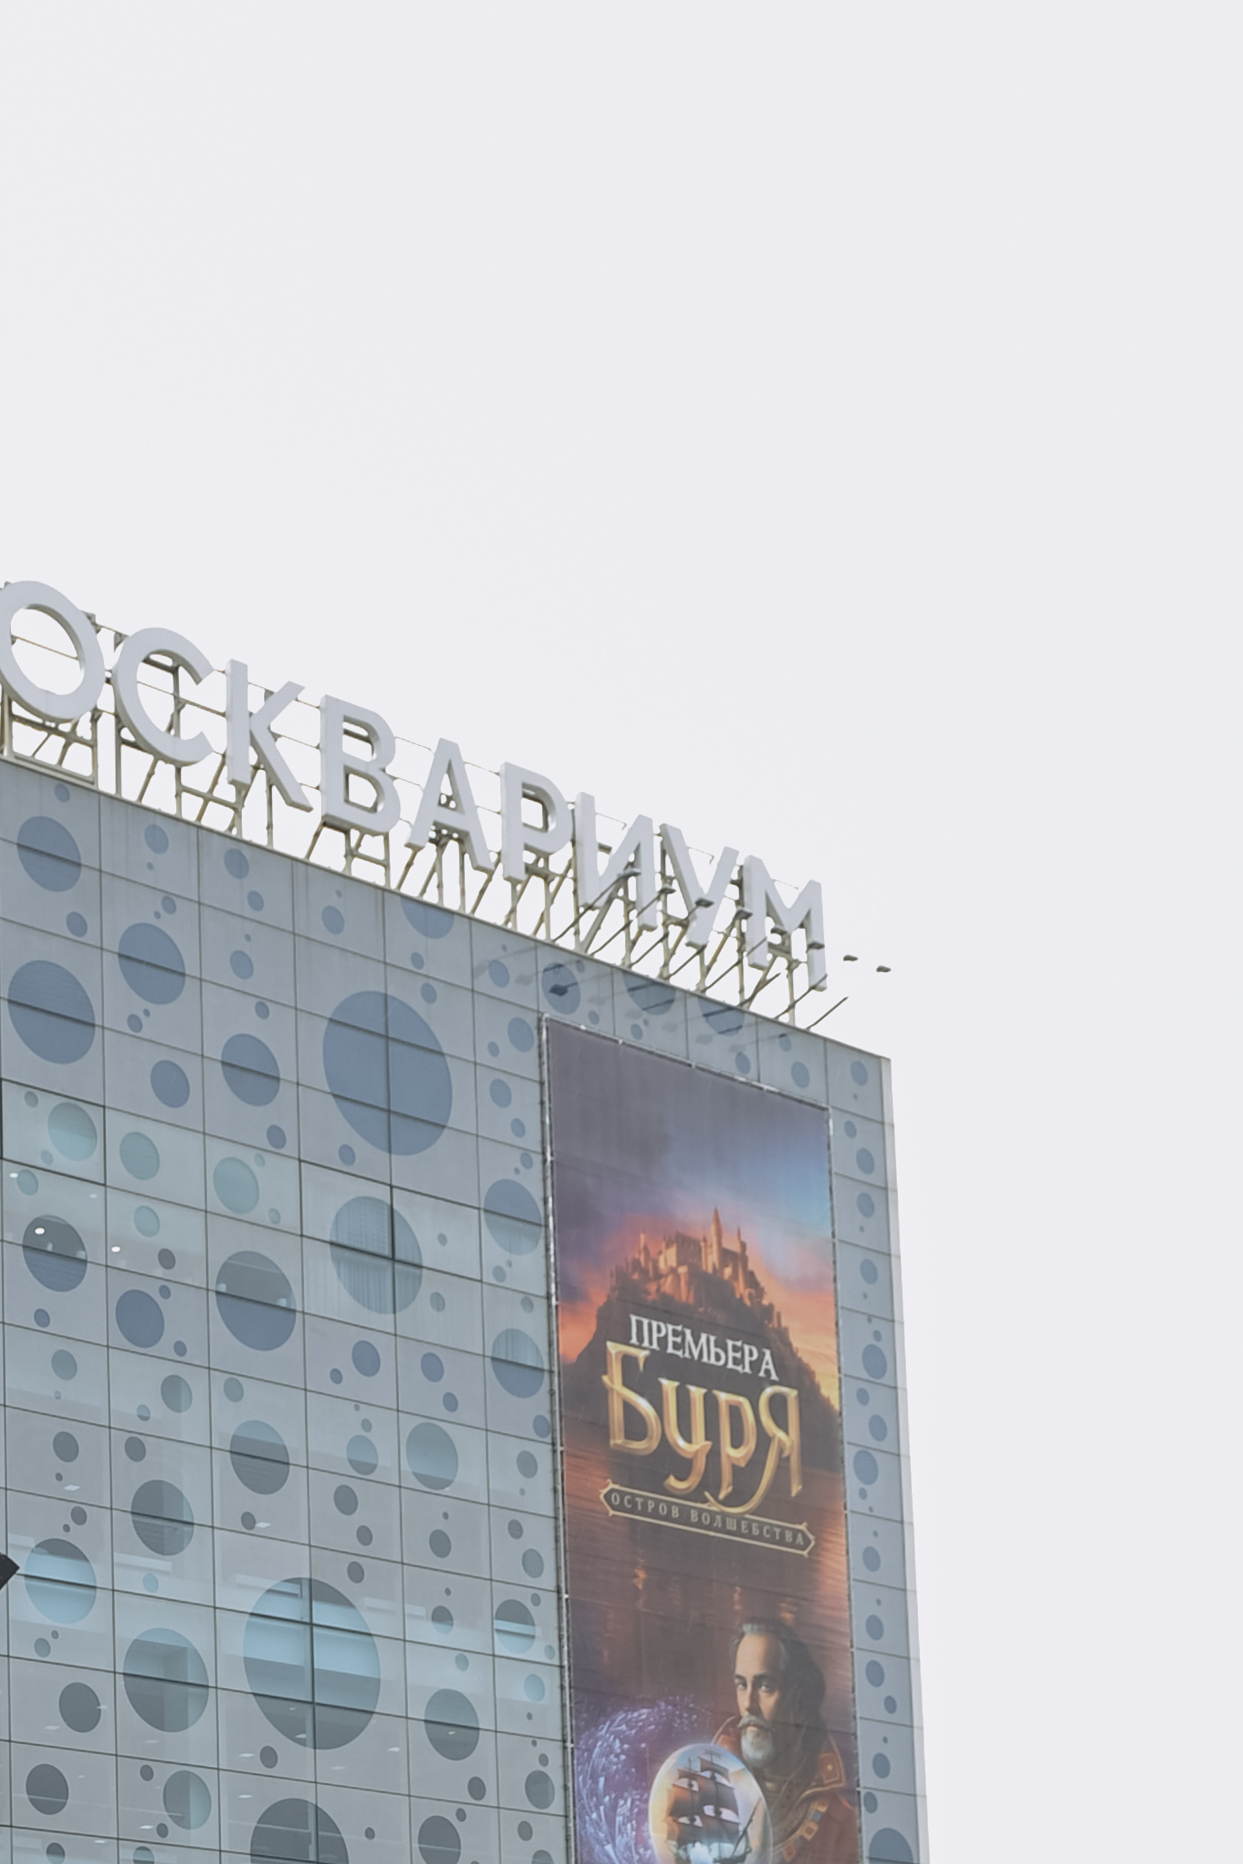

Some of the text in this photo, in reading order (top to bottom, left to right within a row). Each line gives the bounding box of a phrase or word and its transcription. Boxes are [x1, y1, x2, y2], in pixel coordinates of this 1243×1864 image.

[629, 1314, 779, 1381] ПРЕМЬЕРА
[610, 1491, 805, 1546] ОСТРОВ ВОЛШЕБСТВА
